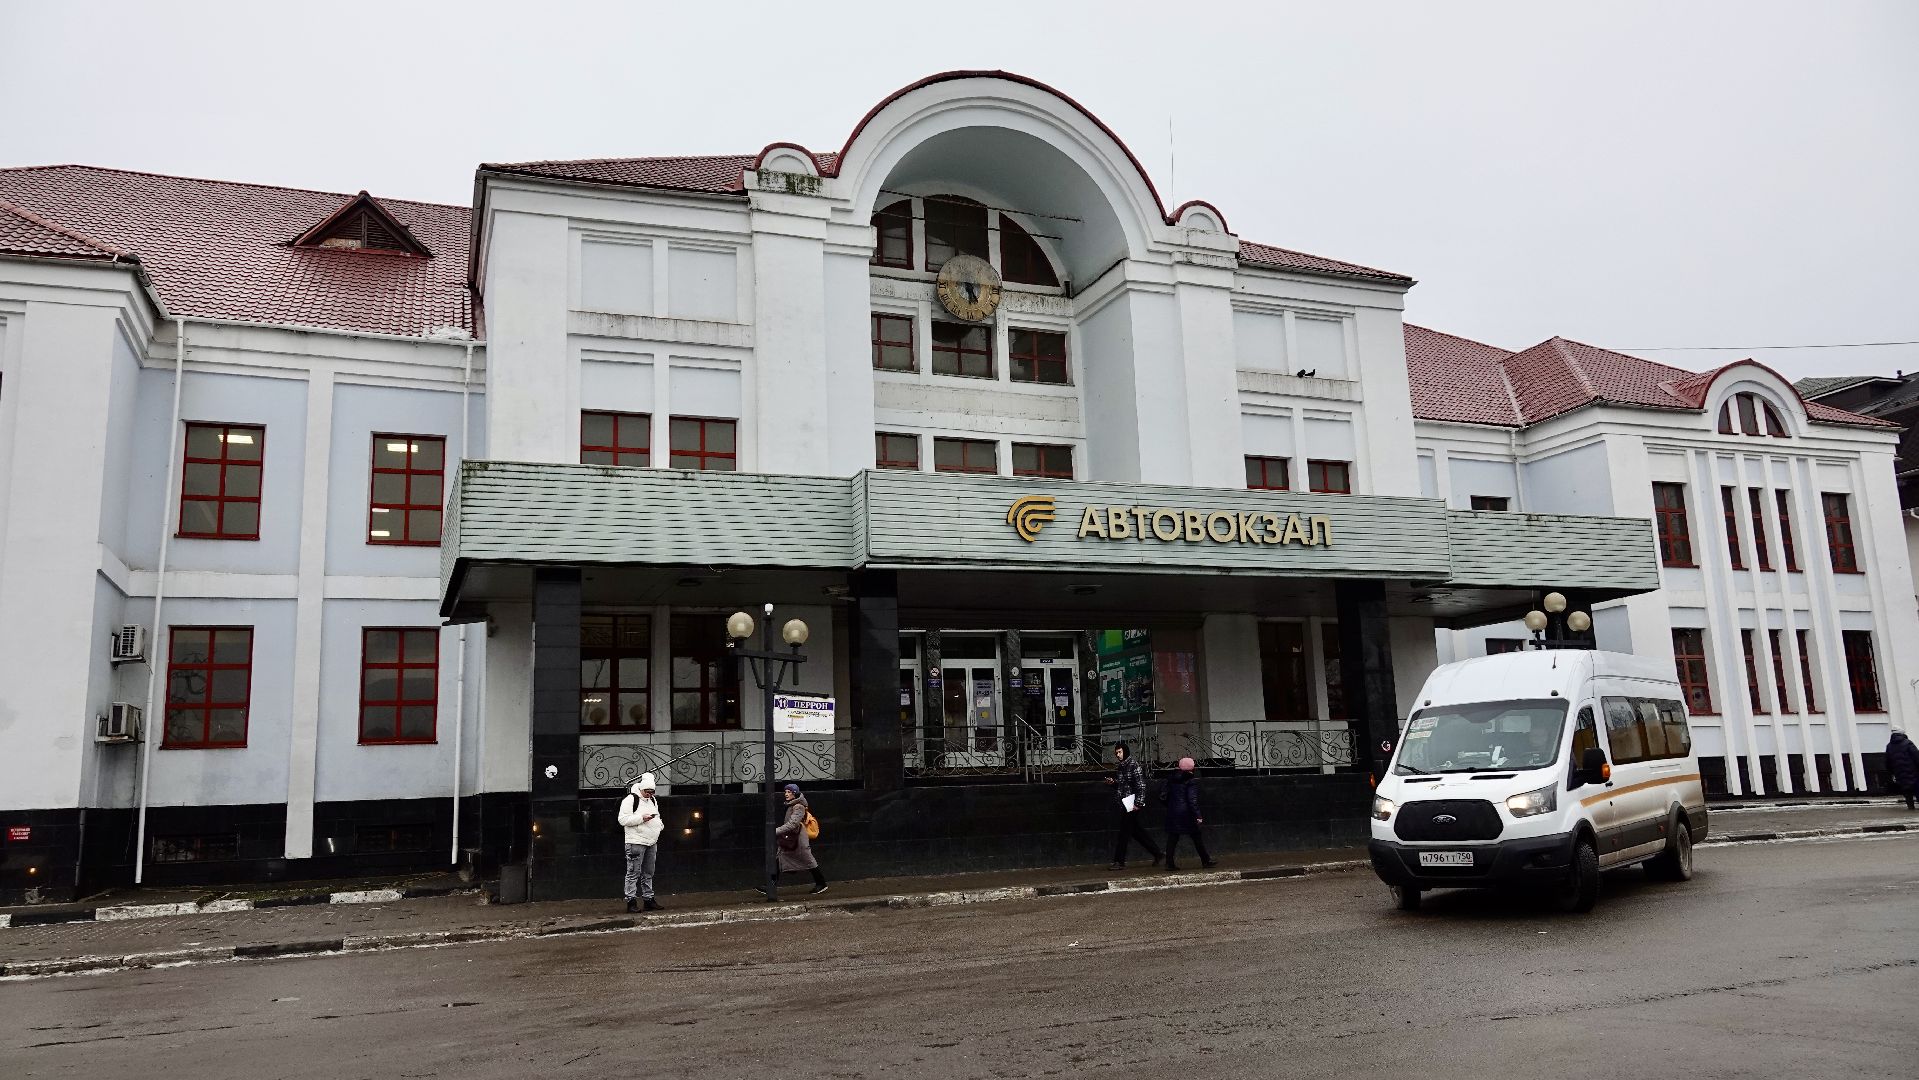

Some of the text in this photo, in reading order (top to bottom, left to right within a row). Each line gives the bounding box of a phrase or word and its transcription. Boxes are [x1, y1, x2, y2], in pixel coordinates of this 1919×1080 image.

[1078, 506, 1333, 547] АВТОВОКЗАЛ
[778, 698, 829, 710] 11 ПЕРРОН
